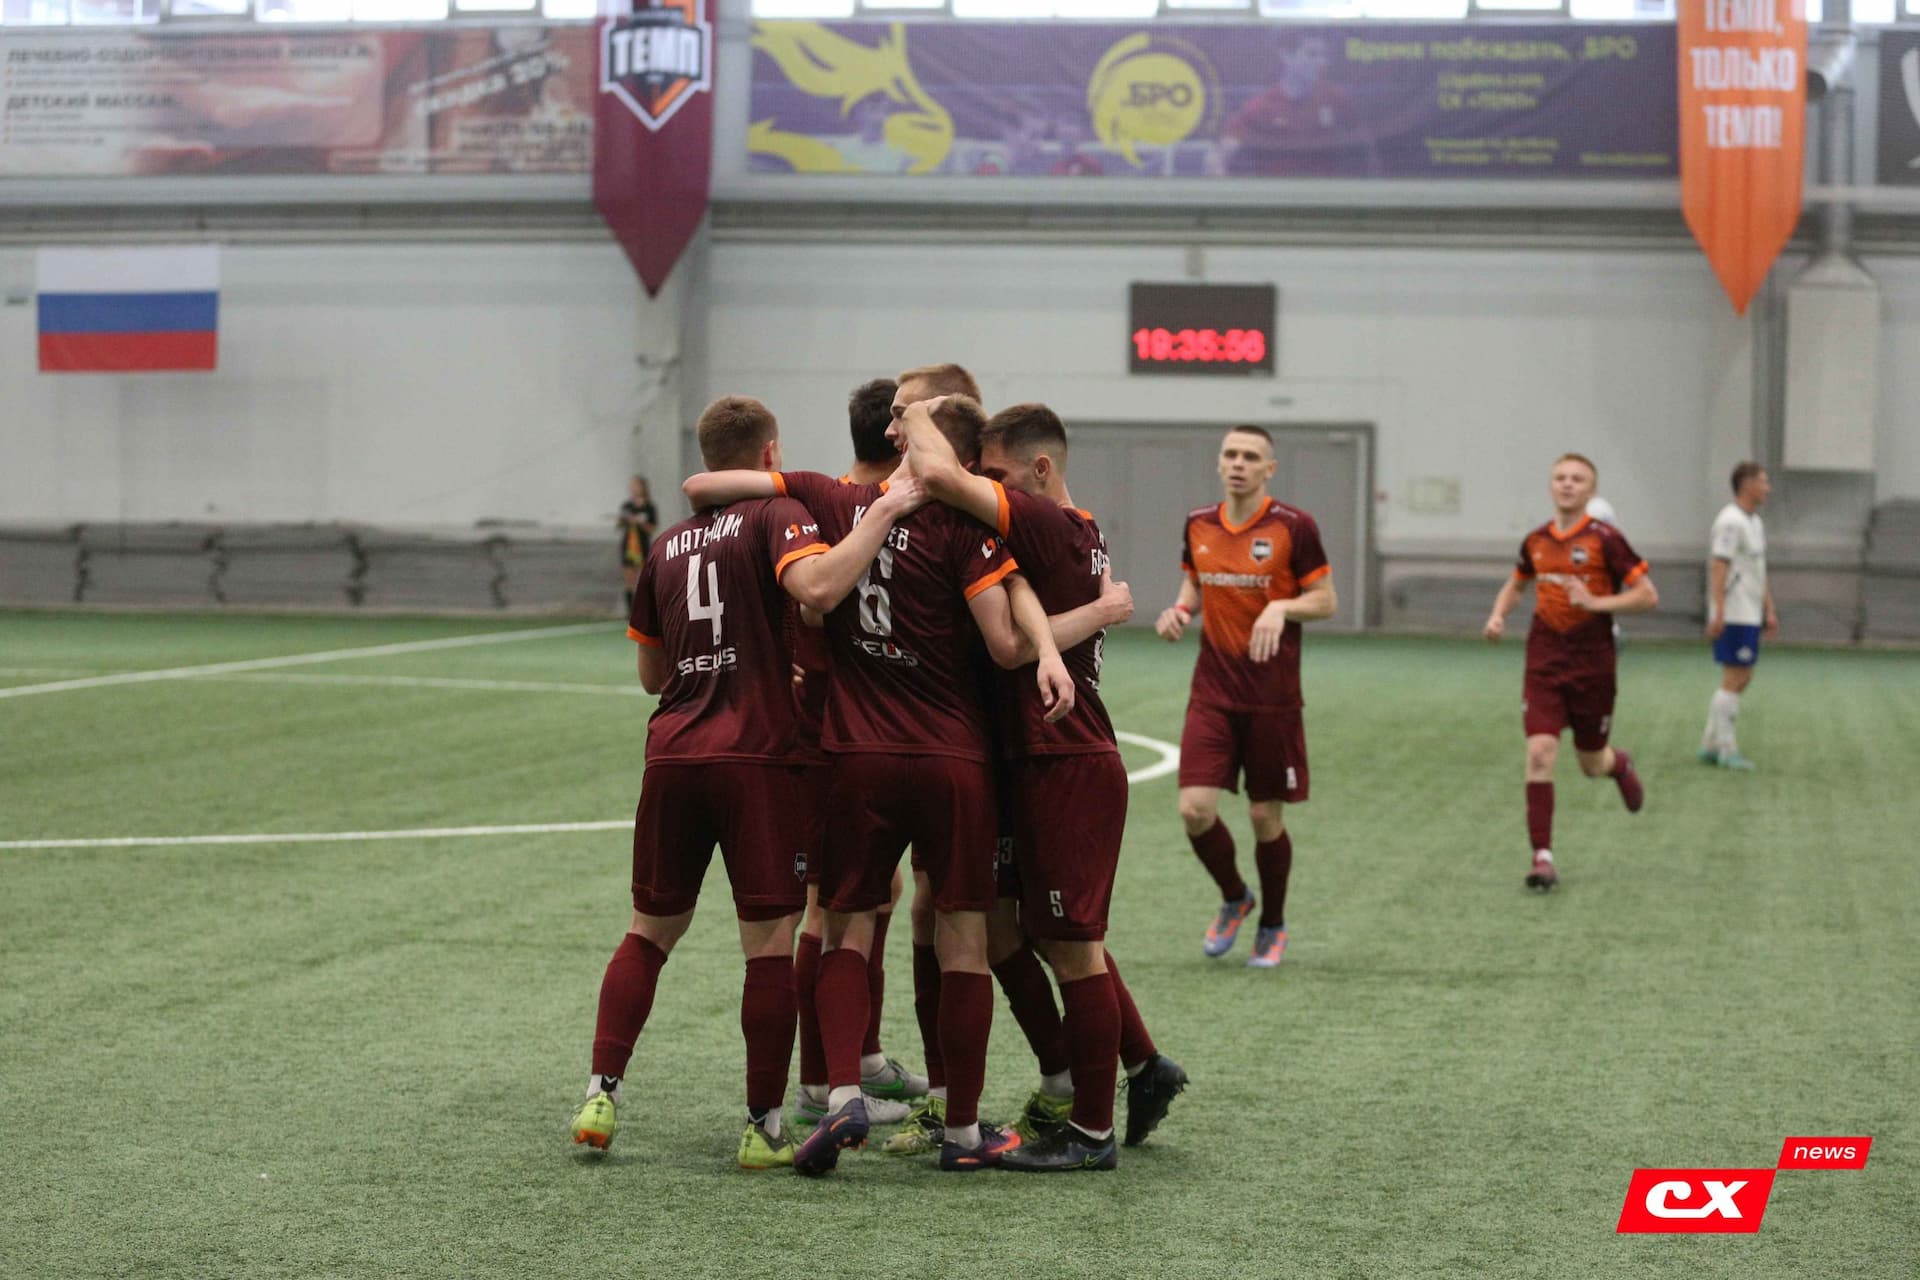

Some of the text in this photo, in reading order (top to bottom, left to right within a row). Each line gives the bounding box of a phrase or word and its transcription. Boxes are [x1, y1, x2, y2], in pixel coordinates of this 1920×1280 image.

[611, 27, 700, 77] ТЕМП
[1690, 47, 1797, 91] ТОЛЬКО
[1702, 106, 1783, 148] ТЕМП!
[666, 513, 744, 561] МАТЫЦИН
[686, 553, 725, 646] 4
[857, 547, 894, 637] 6
[677, 647, 737, 676] SEUS
[1049, 890, 1064, 918] 5
